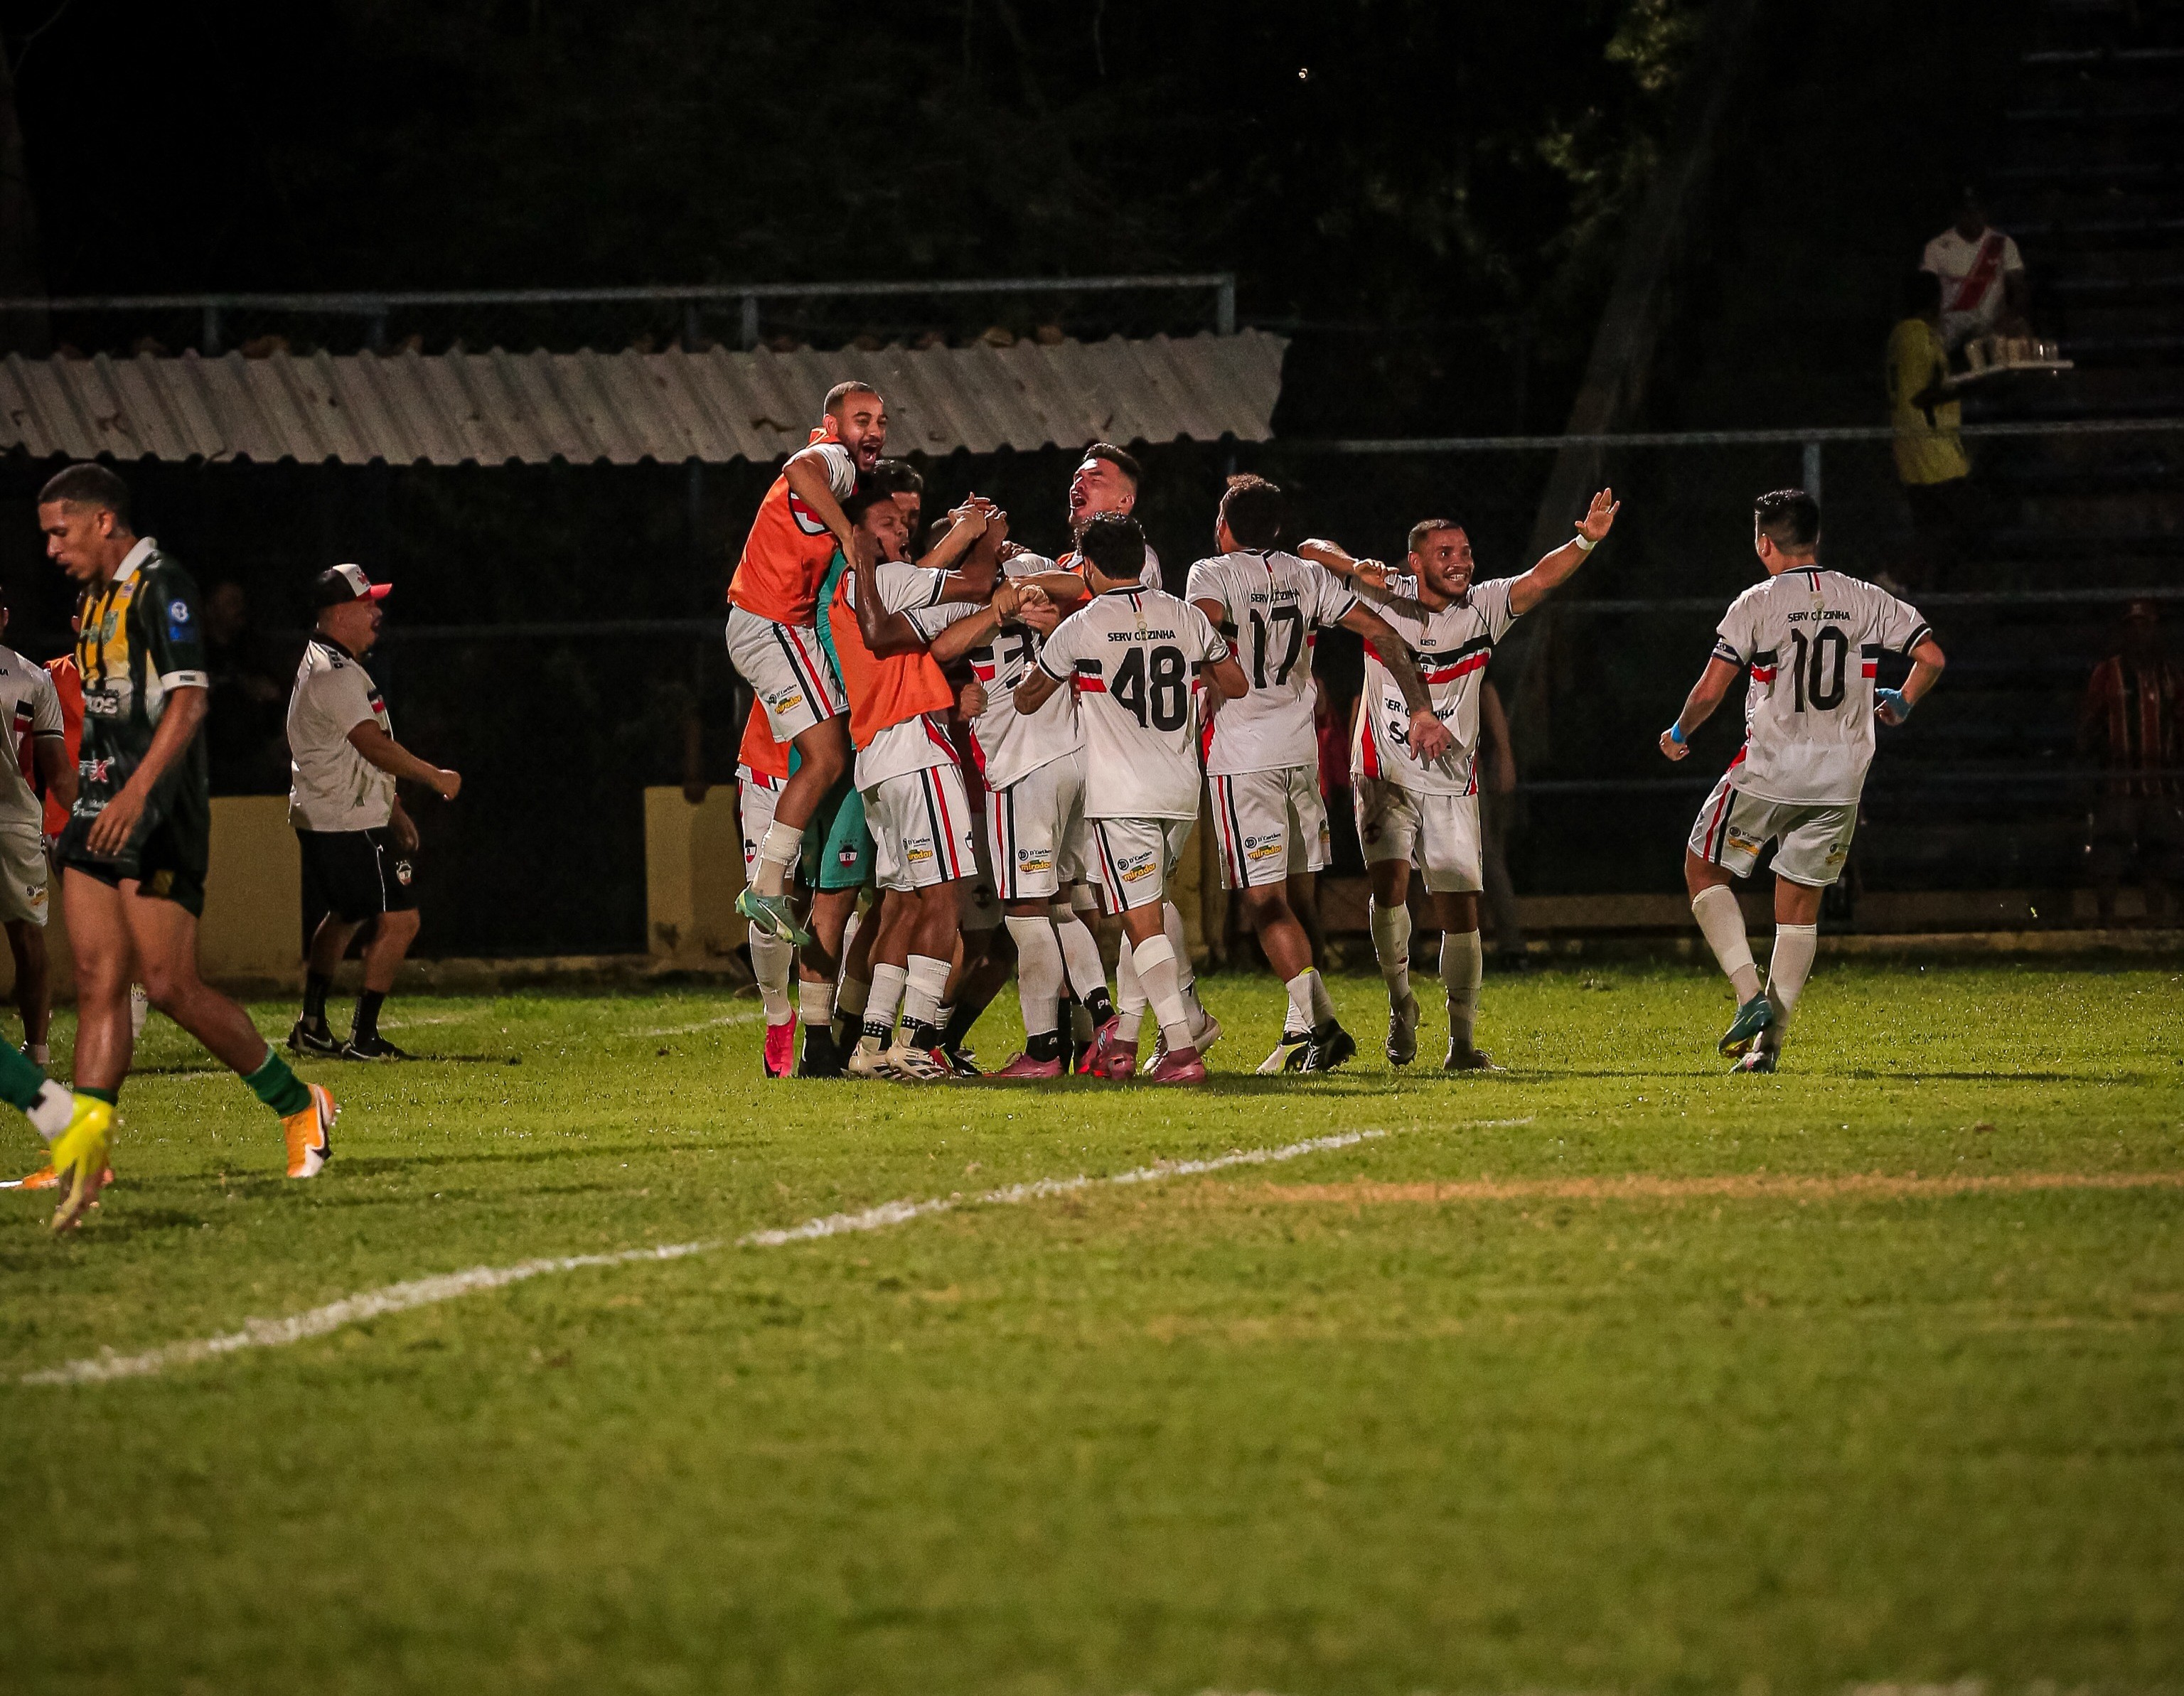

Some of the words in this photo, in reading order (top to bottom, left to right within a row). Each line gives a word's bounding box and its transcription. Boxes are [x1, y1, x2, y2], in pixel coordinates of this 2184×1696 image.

[1251, 593, 1269, 603] SERV
[1788, 611, 1809, 623] SERV
[1107, 632, 1132, 642] SERV
[1250, 605, 1304, 689] 17
[1791, 626, 1849, 713] 10
[1109, 645, 1188, 732] 48
[1124, 863, 1156, 881] mirador
